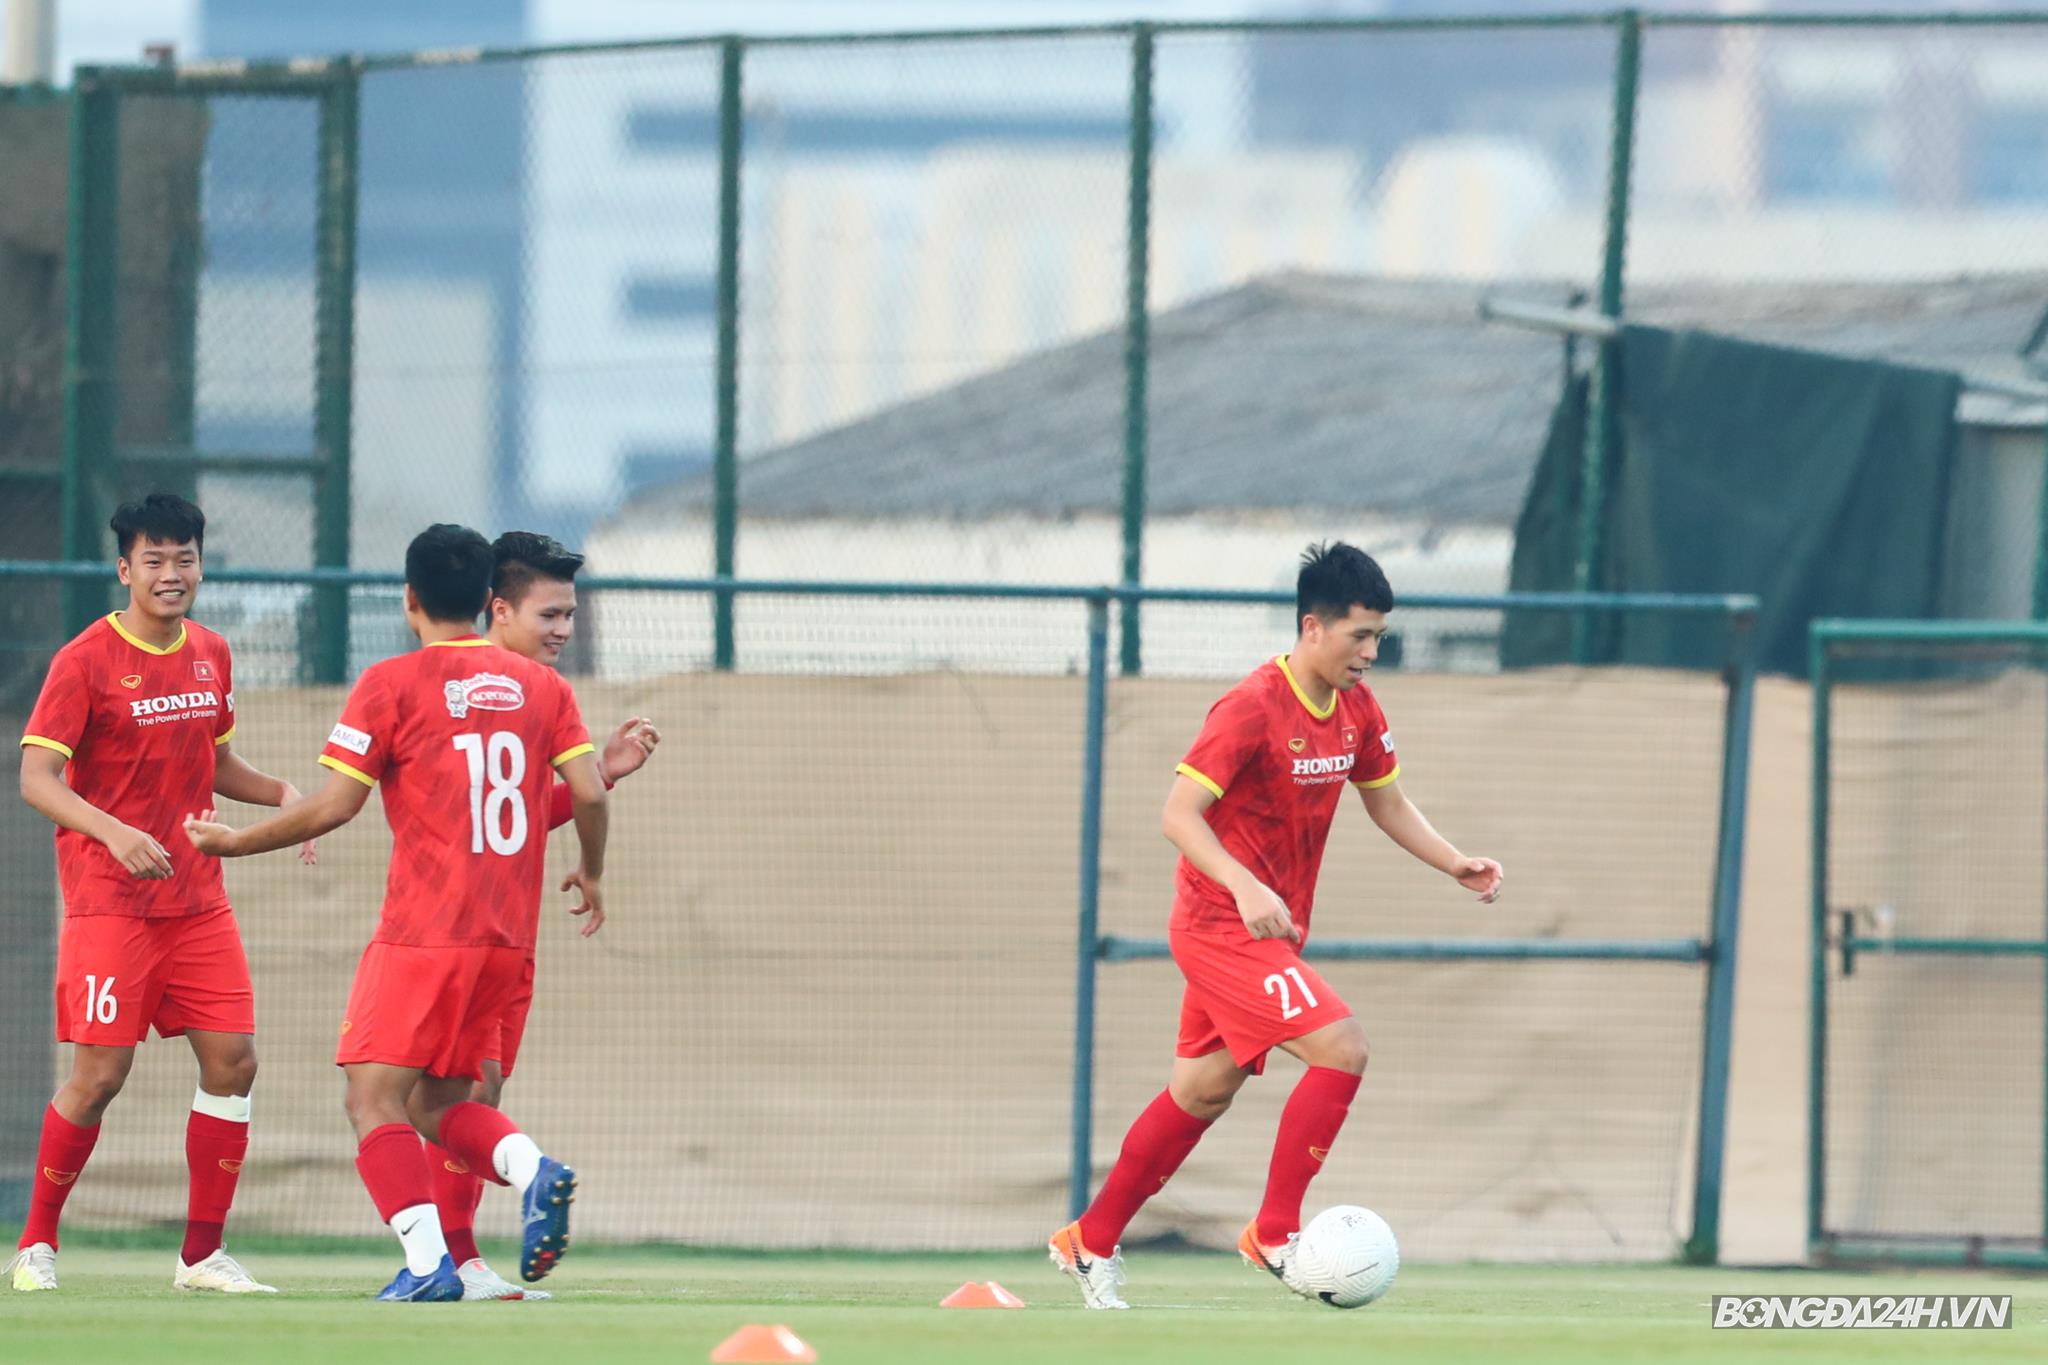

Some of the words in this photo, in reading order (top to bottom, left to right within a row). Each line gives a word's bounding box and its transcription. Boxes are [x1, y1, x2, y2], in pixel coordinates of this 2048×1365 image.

[129, 691, 218, 717] HONDA
[136, 717, 154, 727] The
[155, 713, 180, 724] Power
[181, 711, 190, 720] of
[1291, 752, 1355, 775] HONDA
[452, 731, 528, 856] 18
[85, 974, 118, 1025] 16
[1263, 967, 1319, 1020] 21
